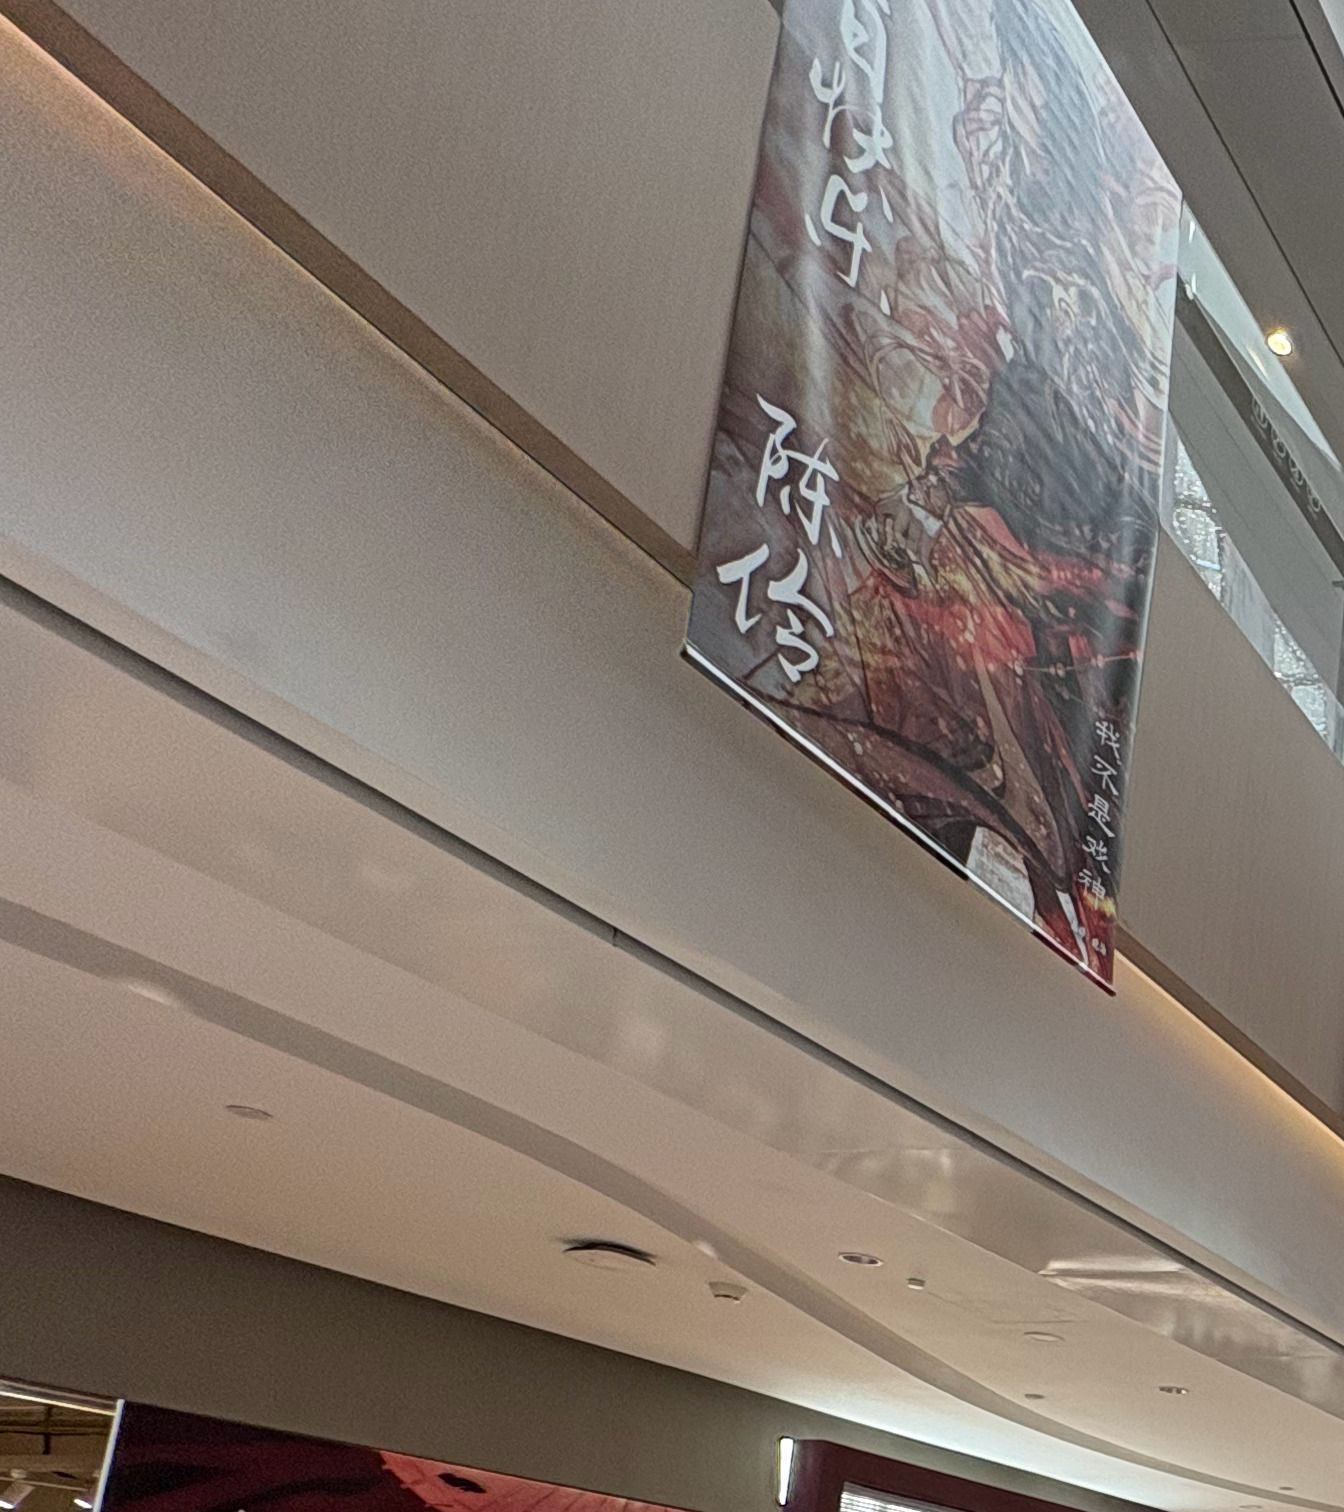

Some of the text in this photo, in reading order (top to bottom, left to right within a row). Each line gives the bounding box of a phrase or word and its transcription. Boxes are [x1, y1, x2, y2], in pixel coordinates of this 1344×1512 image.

[717, 395, 846, 685] 陈伶
[1077, 720, 1124, 910] 我不是戏神
